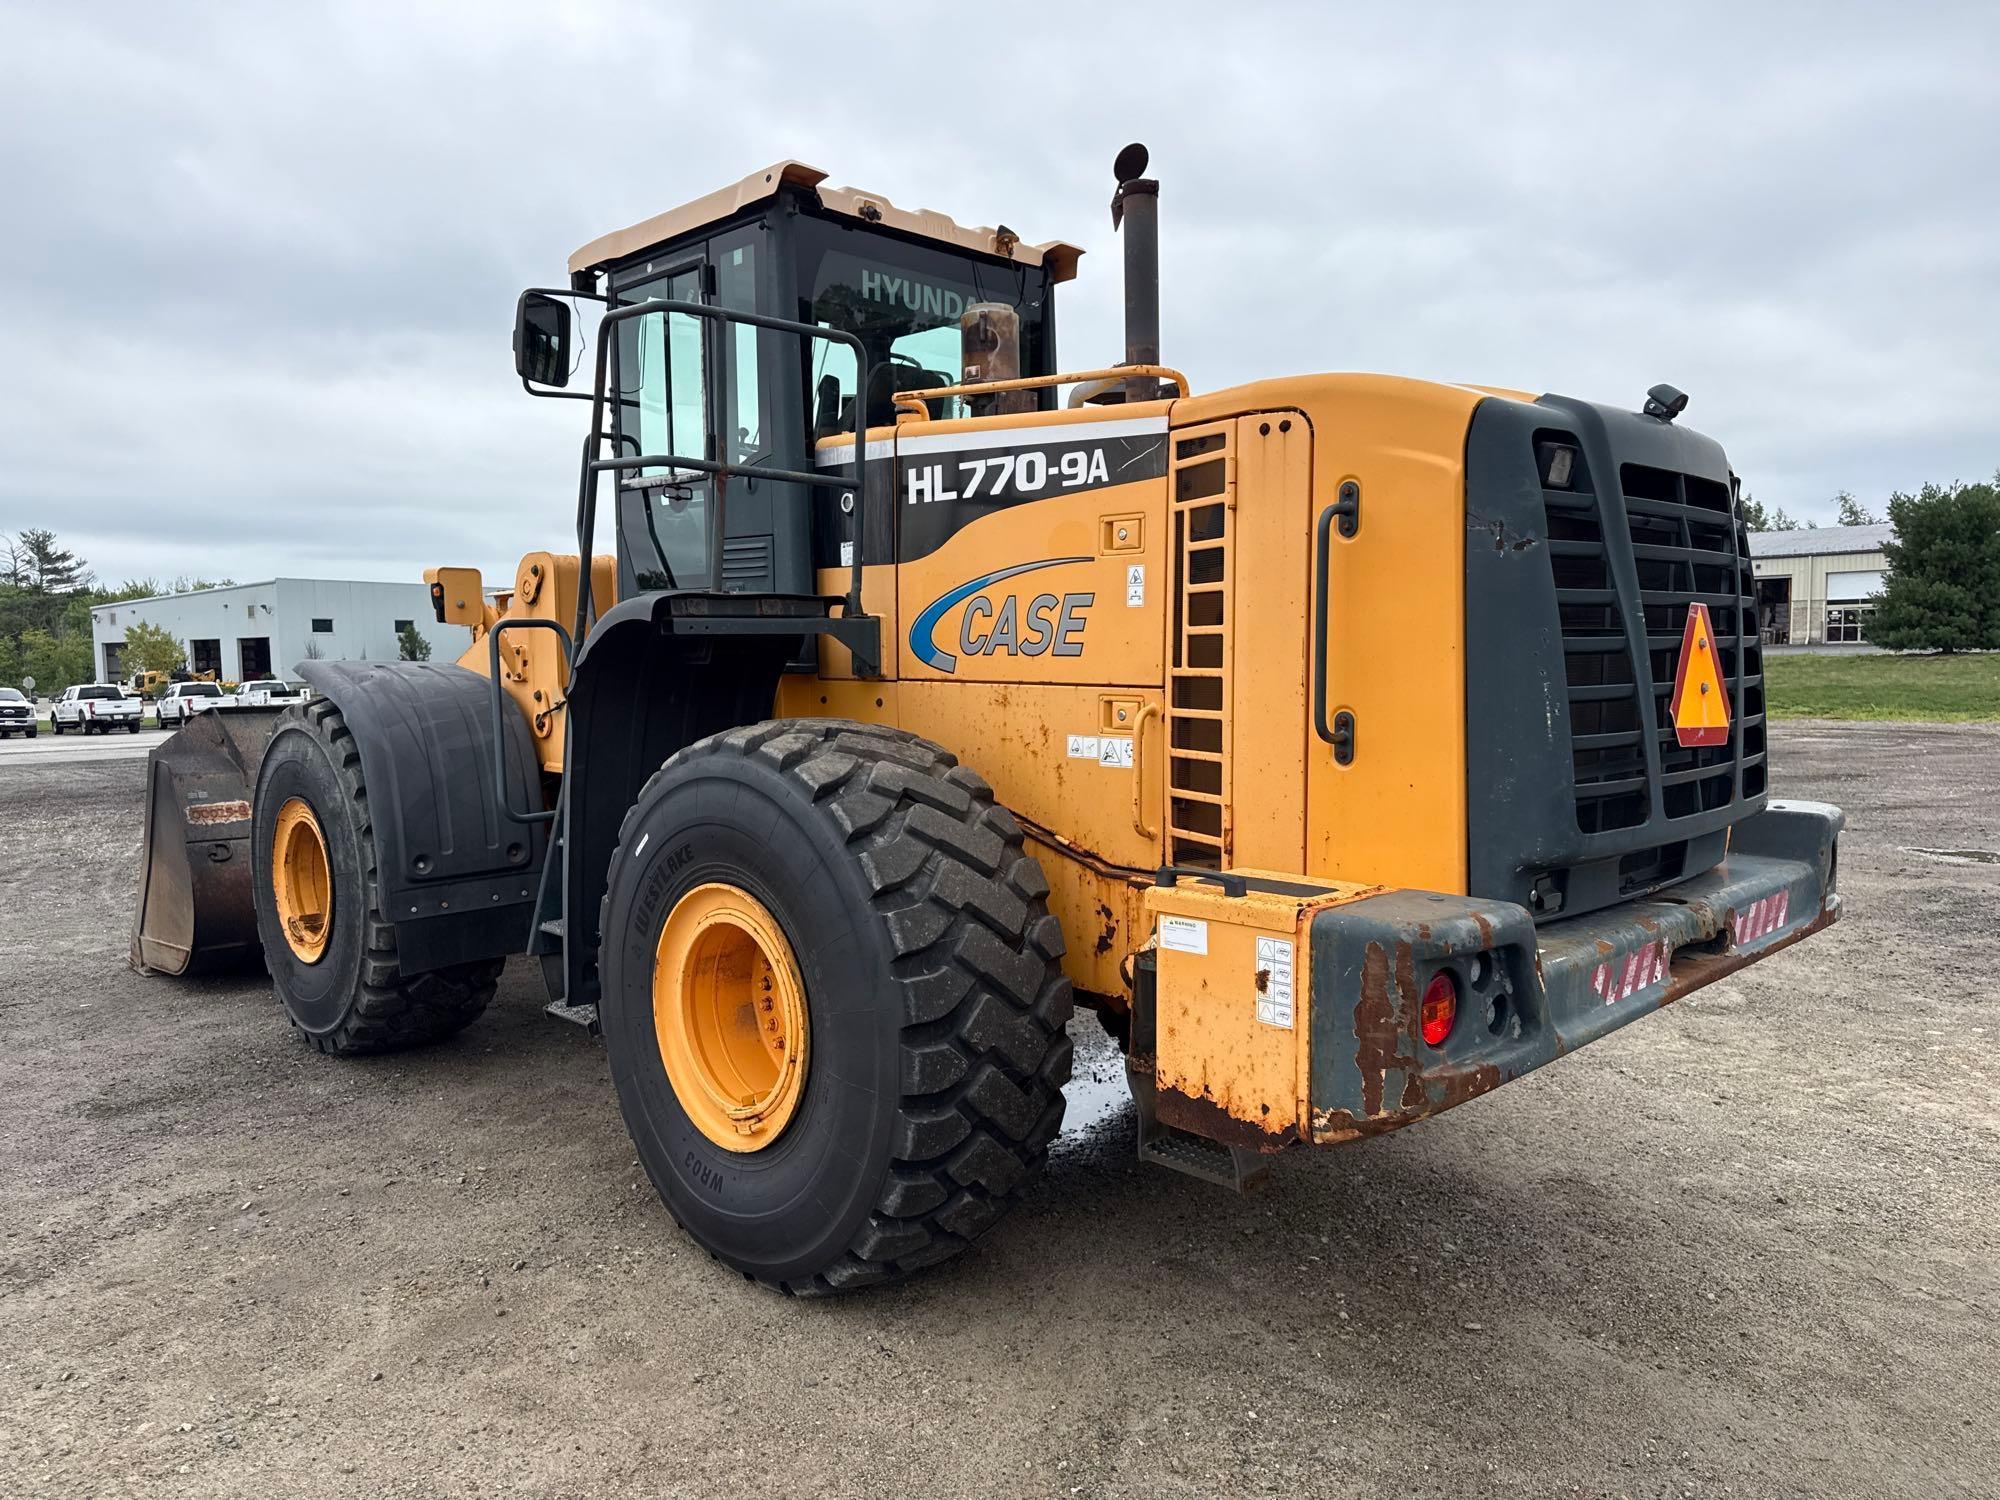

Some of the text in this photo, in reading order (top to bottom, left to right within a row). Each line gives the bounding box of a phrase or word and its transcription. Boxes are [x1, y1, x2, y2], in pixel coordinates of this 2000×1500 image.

[861, 268, 982, 321] HYUND
[907, 448, 1110, 505] HL770-9A
[959, 591, 1096, 658] CASE
[634, 843, 696, 937] WESTLAKE
[684, 1151, 724, 1194] WR03
